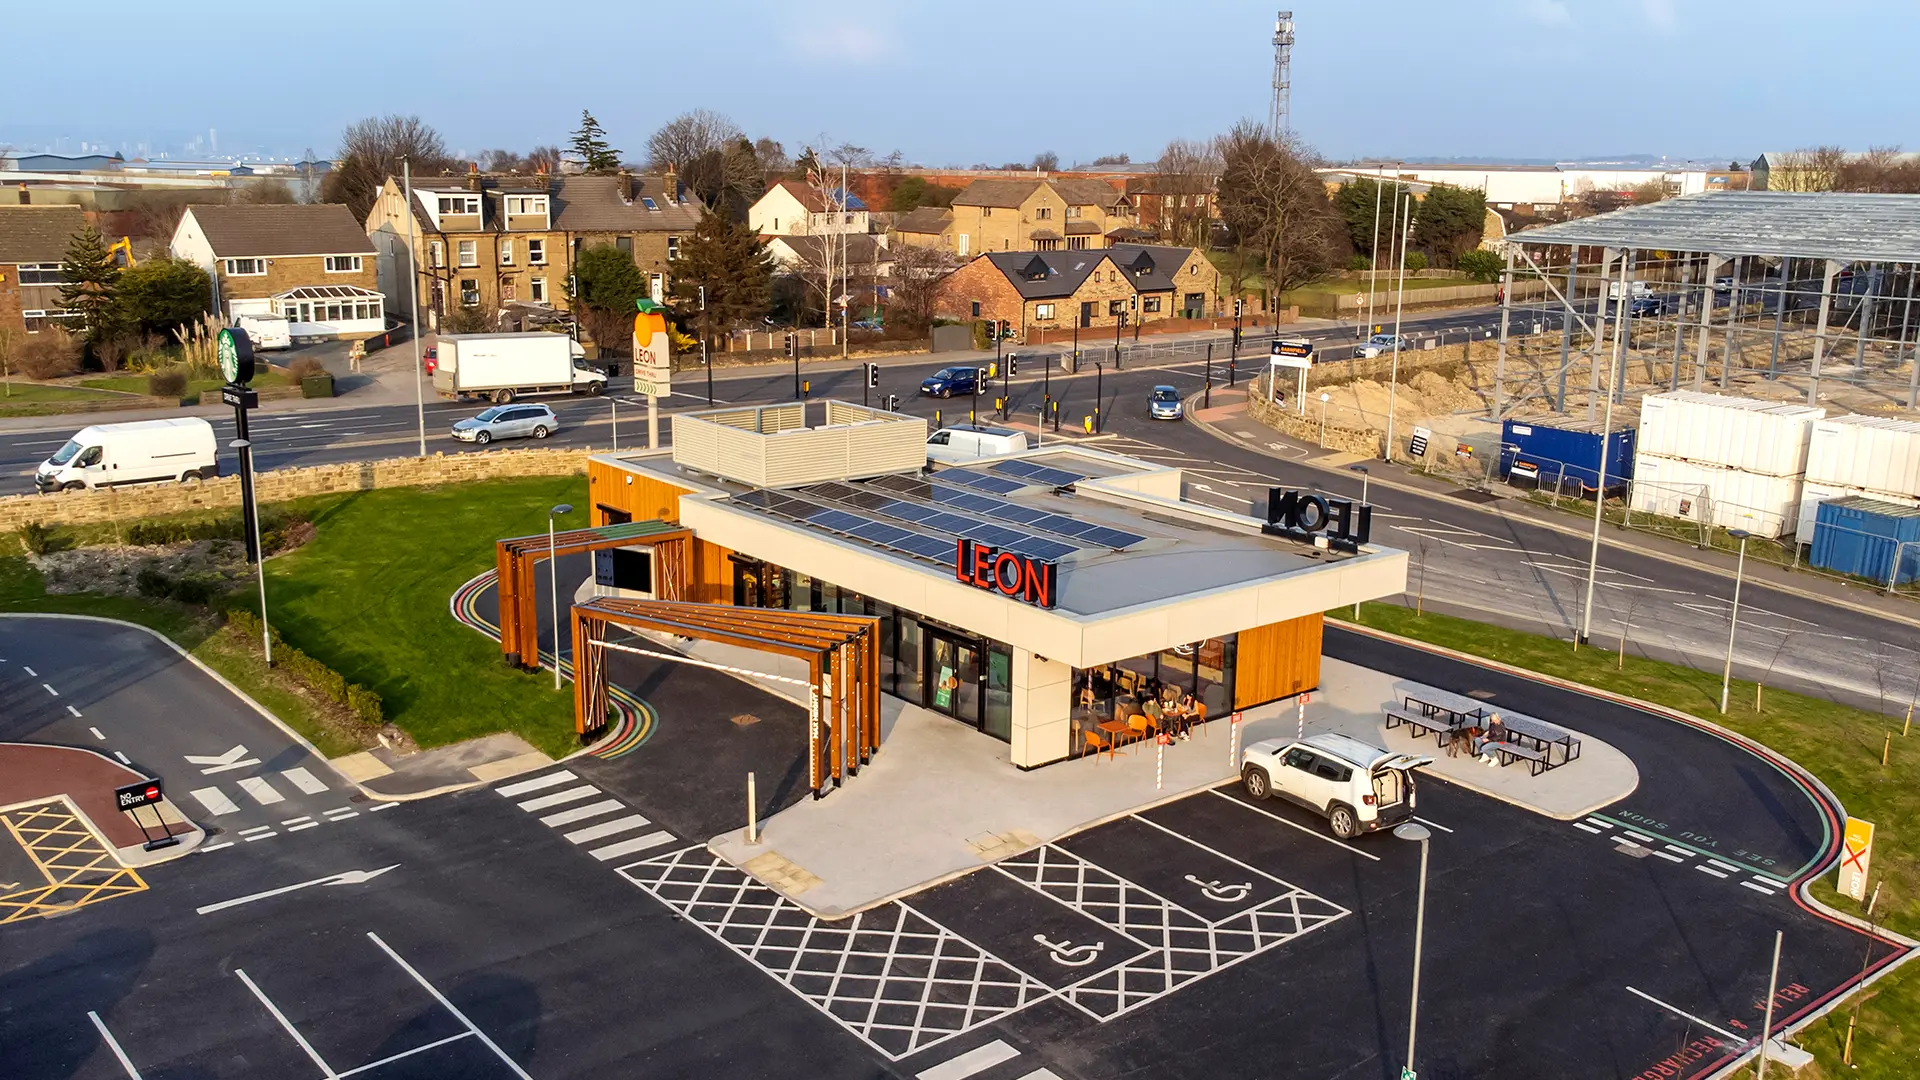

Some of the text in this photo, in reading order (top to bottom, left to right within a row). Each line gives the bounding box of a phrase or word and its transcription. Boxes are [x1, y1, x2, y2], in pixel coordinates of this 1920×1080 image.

[635, 348, 656, 365] LEON
[956, 538, 1055, 608] LEON
[120, 792, 132, 801] NO
[121, 794, 145, 806] ENTRY
[1618, 810, 1776, 866] SEE YOU SOON
[1850, 871, 1862, 897] LEON
[1753, 982, 1810, 1013] RELAX
[1632, 1035, 1724, 1080] RECHARG
